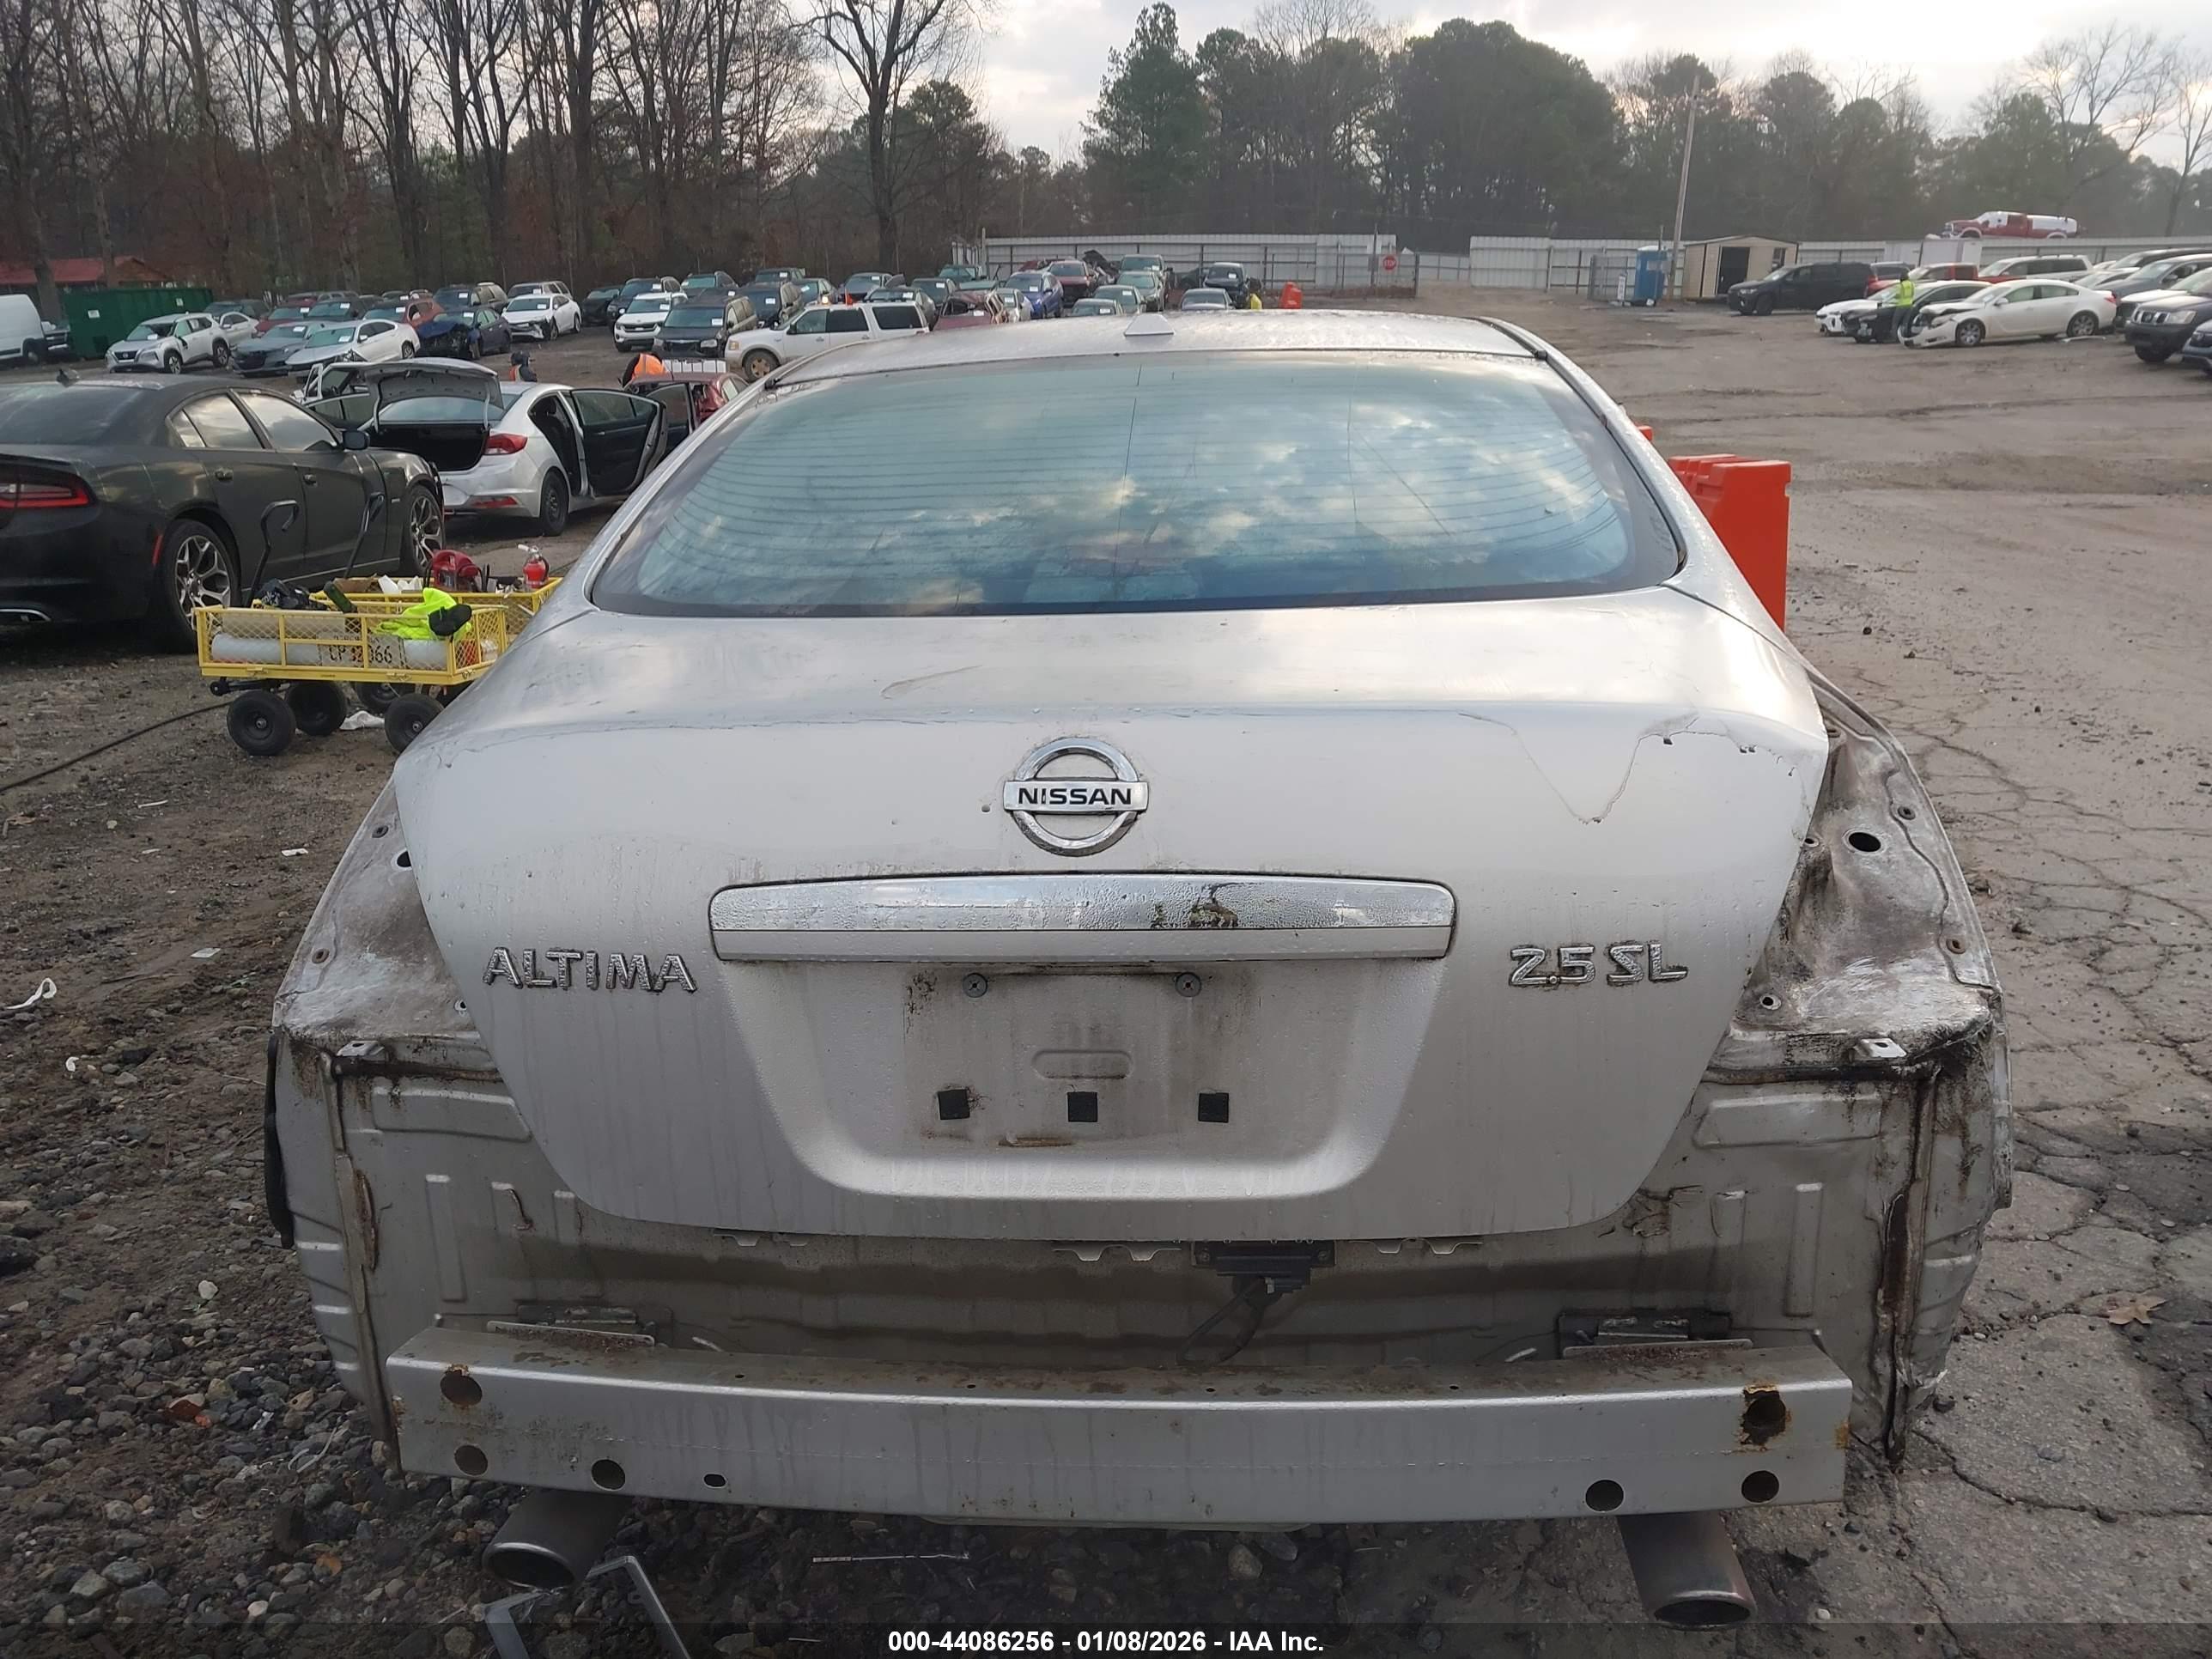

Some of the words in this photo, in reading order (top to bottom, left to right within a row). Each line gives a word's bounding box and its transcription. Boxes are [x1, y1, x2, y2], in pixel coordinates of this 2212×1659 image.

[1018, 787, 1132, 805] NISSAN
[483, 946, 697, 993] ALTIMA
[1510, 945, 1596, 987] 2.5
[1607, 943, 1689, 985] SL
